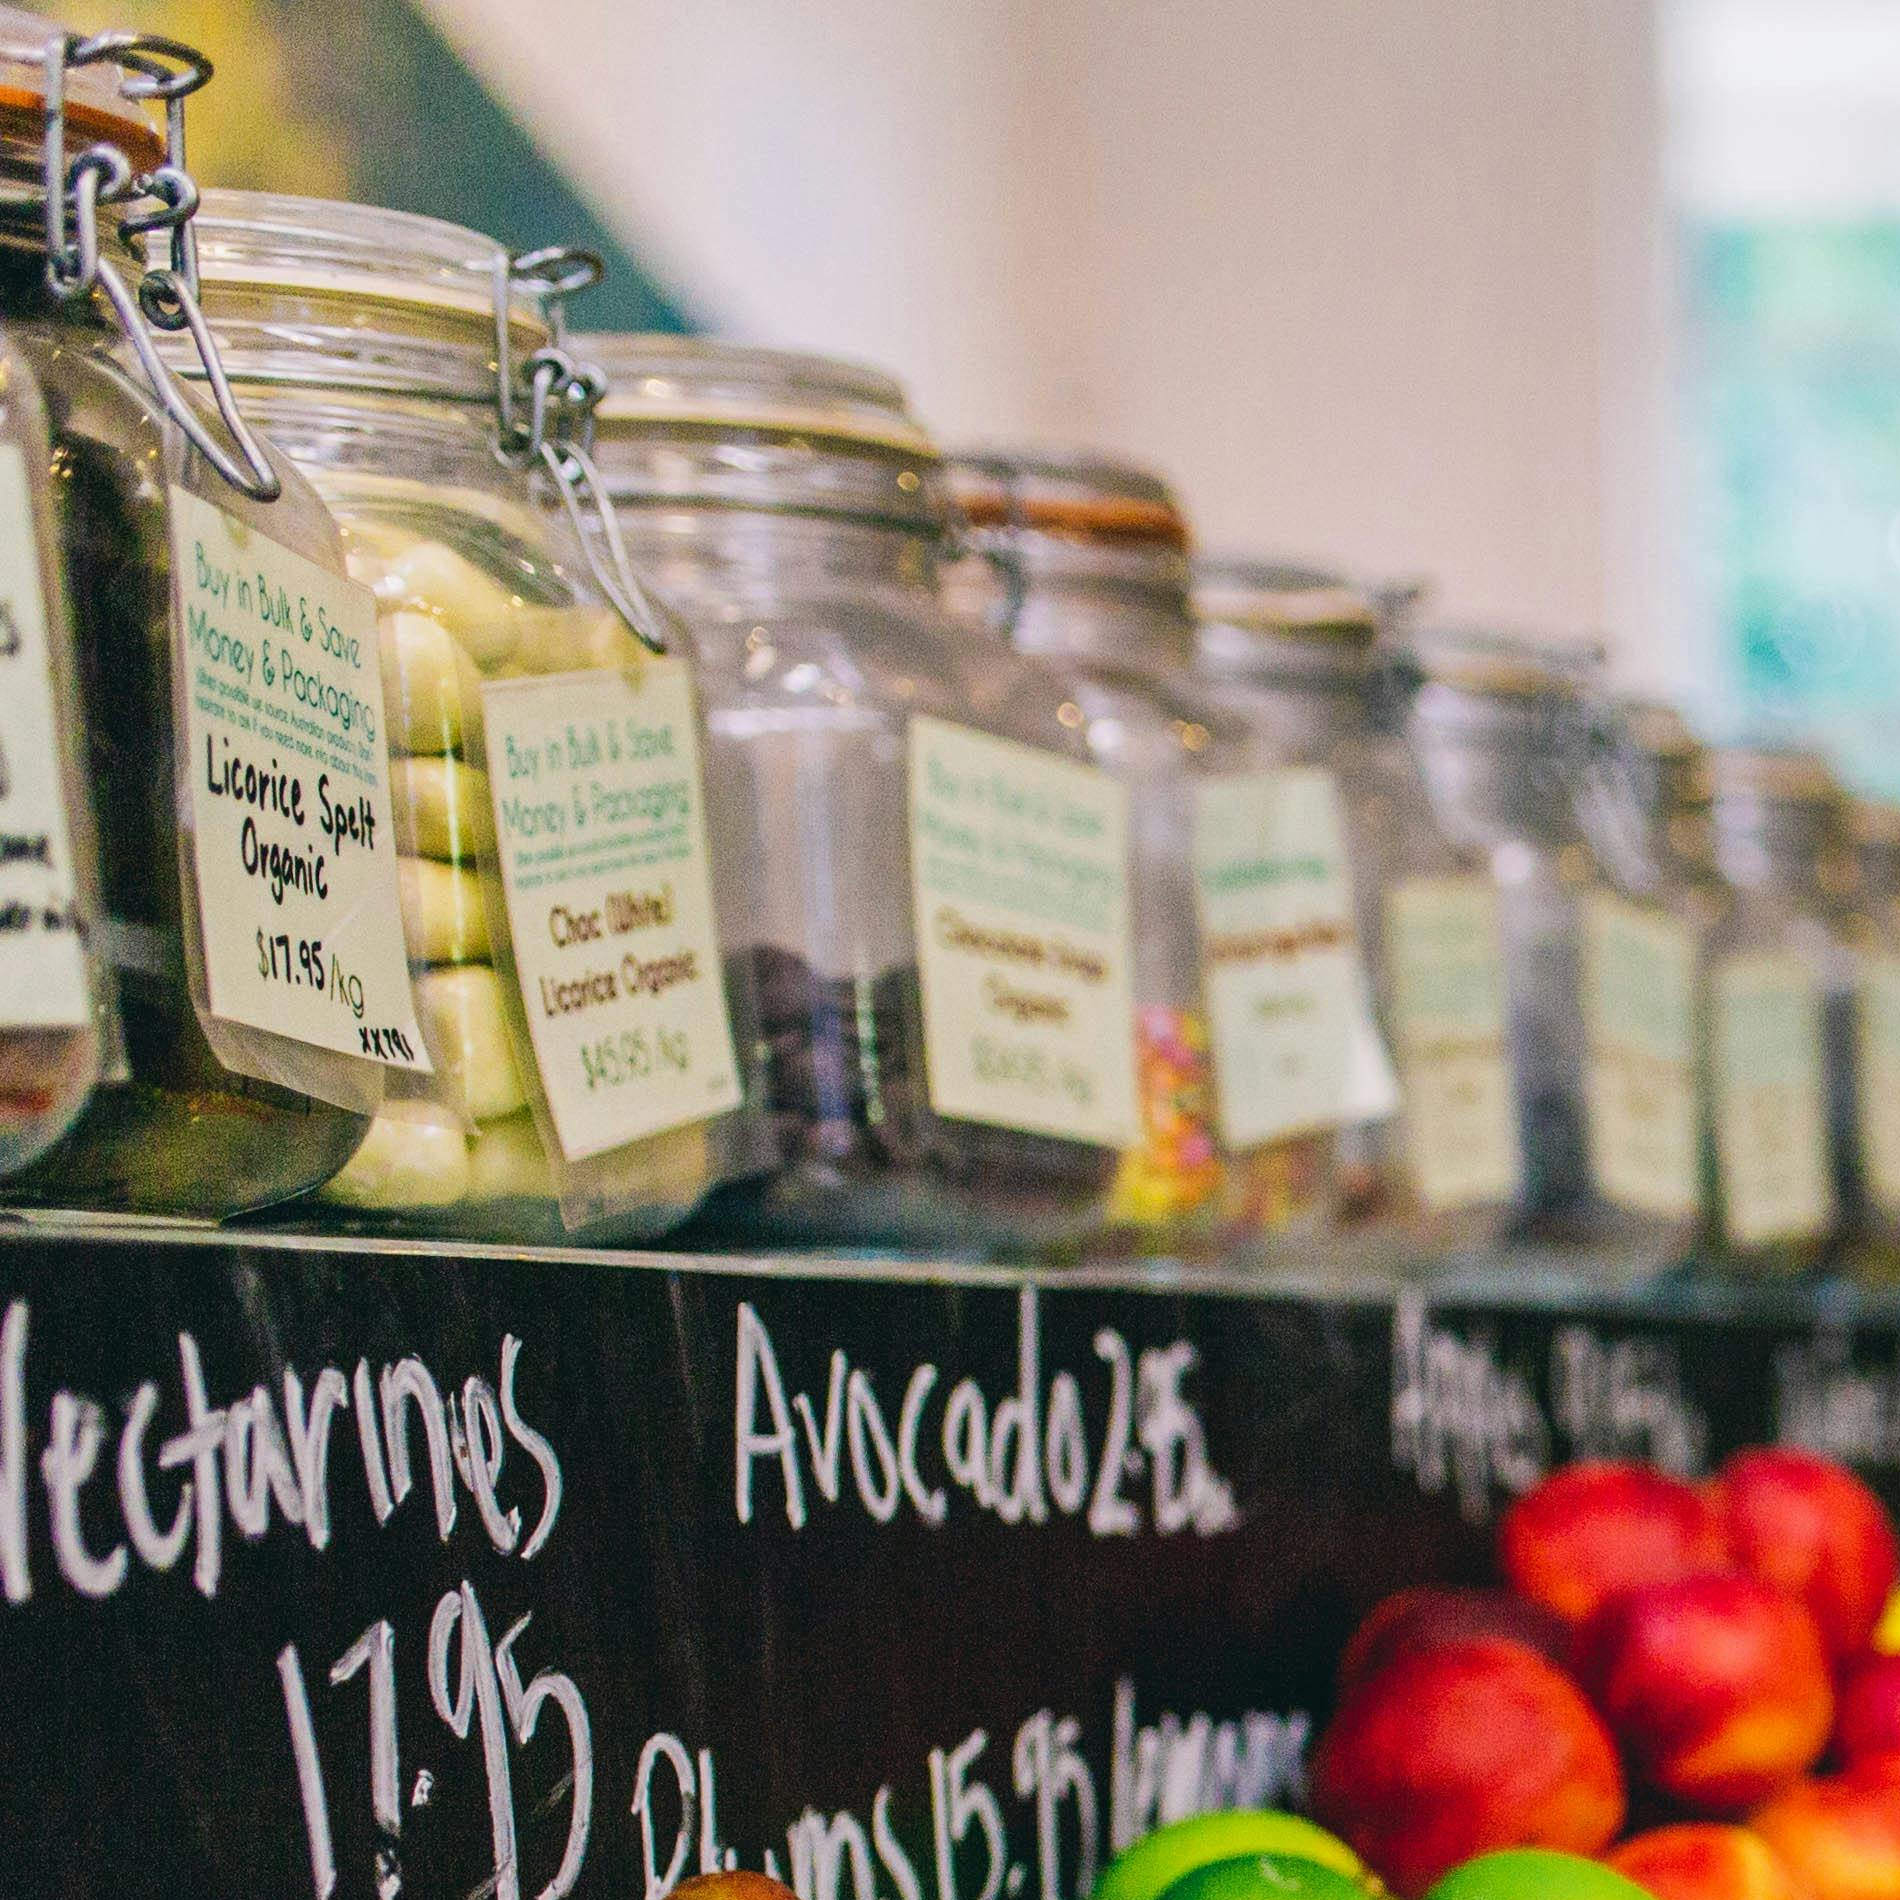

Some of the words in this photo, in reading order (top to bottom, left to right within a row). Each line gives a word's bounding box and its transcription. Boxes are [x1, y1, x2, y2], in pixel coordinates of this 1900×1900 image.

[196, 541, 229, 608] Buy
[236, 569, 253, 612] in
[258, 573, 294, 636] Bulk
[299, 597, 312, 641] &
[319, 606, 361, 669] Save
[188, 602, 254, 684] Money
[262, 639, 275, 686] &
[281, 649, 376, 744] Packaging
[206, 732, 305, 826] Licorice
[318, 773, 377, 857] Spelt
[241, 815, 329, 905] Organic
[539, 969, 619, 1019] Licorice
[735, 1285, 1088, 1530] Avocado
